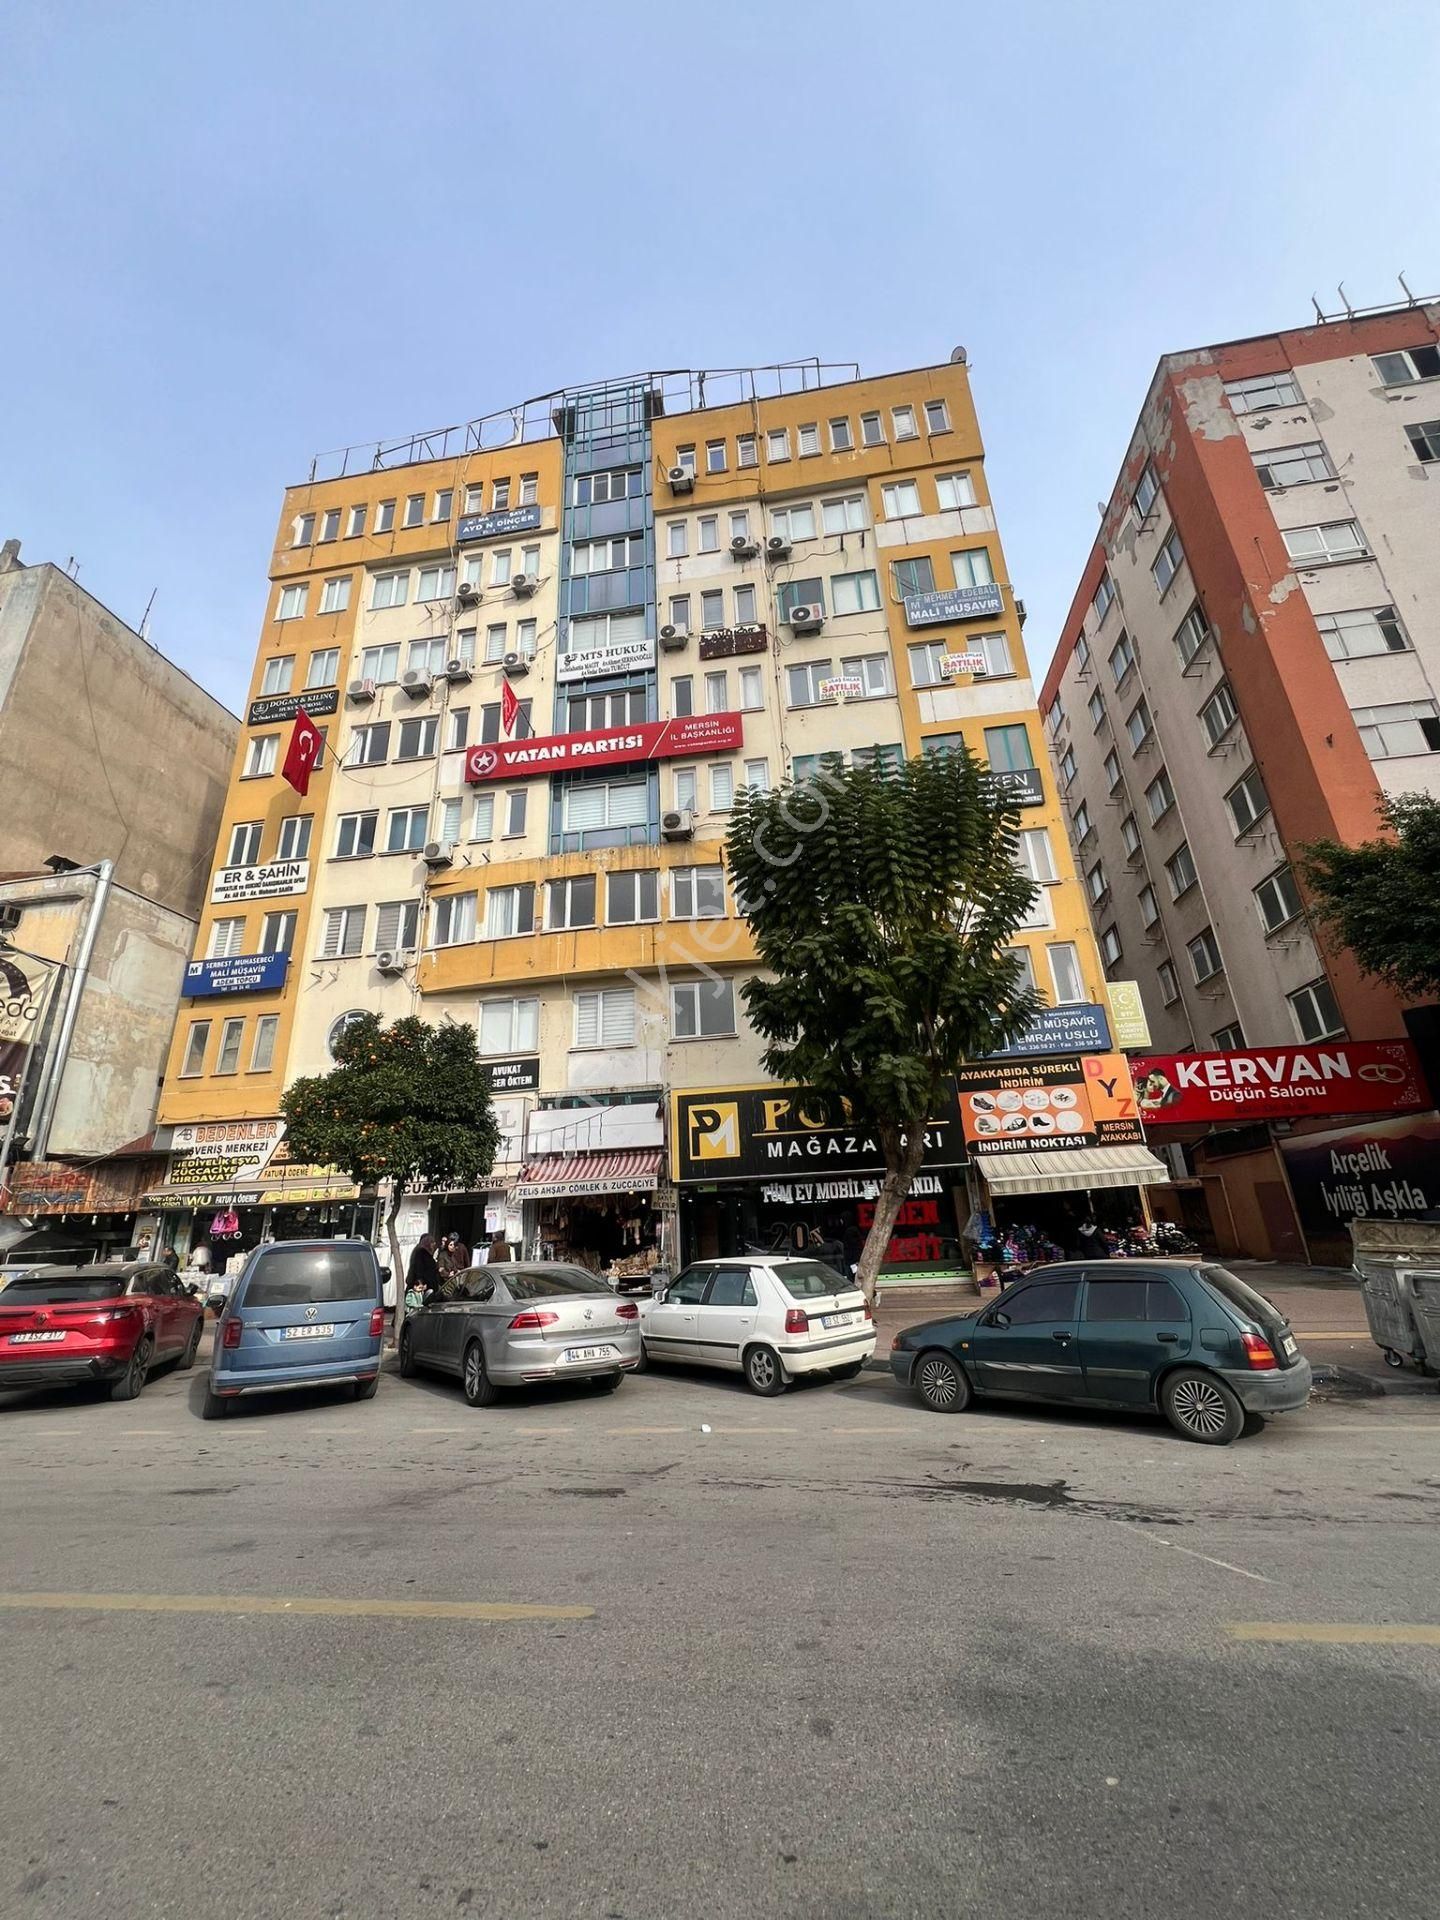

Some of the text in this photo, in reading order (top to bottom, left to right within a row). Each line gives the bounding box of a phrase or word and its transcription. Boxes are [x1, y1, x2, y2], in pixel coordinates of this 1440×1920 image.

[462, 522, 494, 534] AYDN
[923, 591, 958, 604] MEHMET
[580, 643, 648, 661] MTS HUKUK
[943, 659, 983, 669] SATILIK
[821, 682, 861, 694] SATILIK
[685, 721, 719, 731] MERSİN
[681, 726, 735, 740] BAŞKANLIĞI
[503, 734, 643, 765] VATAN PARTİSİ
[223, 863, 300, 884] ER & ŞAHİN
[205, 954, 275, 969] SERBEST MUHASEBECİ
[210, 965, 266, 978] MALİ MÜŞAVİR
[216, 978, 235, 986] ADEM
[1043, 1014, 1096, 1029] MÜŞAVİR
[1017, 1029, 1099, 1044] EMRAH USLU
[491, 1064, 522, 1077] AVUKAT
[960, 1061, 1081, 1081] AYAKKABIDA SÜREKLİ
[1085, 1059, 1104, 1078] D
[1175, 1052, 1352, 1089] KERVAN
[507, 1075, 533, 1087] ÖKTEM
[1000, 1077, 1044, 1089] İNDİRİM
[1097, 1077, 1118, 1098] Y
[1209, 1084, 1327, 1103] Düğün Salonu
[1116, 1098, 1136, 1118] Z
[195, 1121, 278, 1143] BEDENLER
[1102, 1122, 1135, 1132] MERSİN
[978, 1135, 1087, 1152] İNDİRİM NOKTASI
[1100, 1132, 1142, 1143] AYAKKABI
[225, 1141, 269, 1153] MERKEZİ
[767, 1131, 943, 1158] MAĞAZAARI
[230, 1154, 260, 1166] EŞYA
[1330, 1142, 1392, 1180] Arçelik
[172, 1165, 238, 1177] ZÜCCACİYE
[171, 1173, 232, 1184] HIRDAVAT
[540, 1185, 566, 1195] AHŞAP
[760, 1182, 794, 1204] TÜM
[794, 1183, 813, 1201] EV
[187, 1195, 211, 1206] WU
[1320, 1180, 1428, 1218] İyiliği Aşkla
[287, 1325, 332, 1337] 52 ER 535
